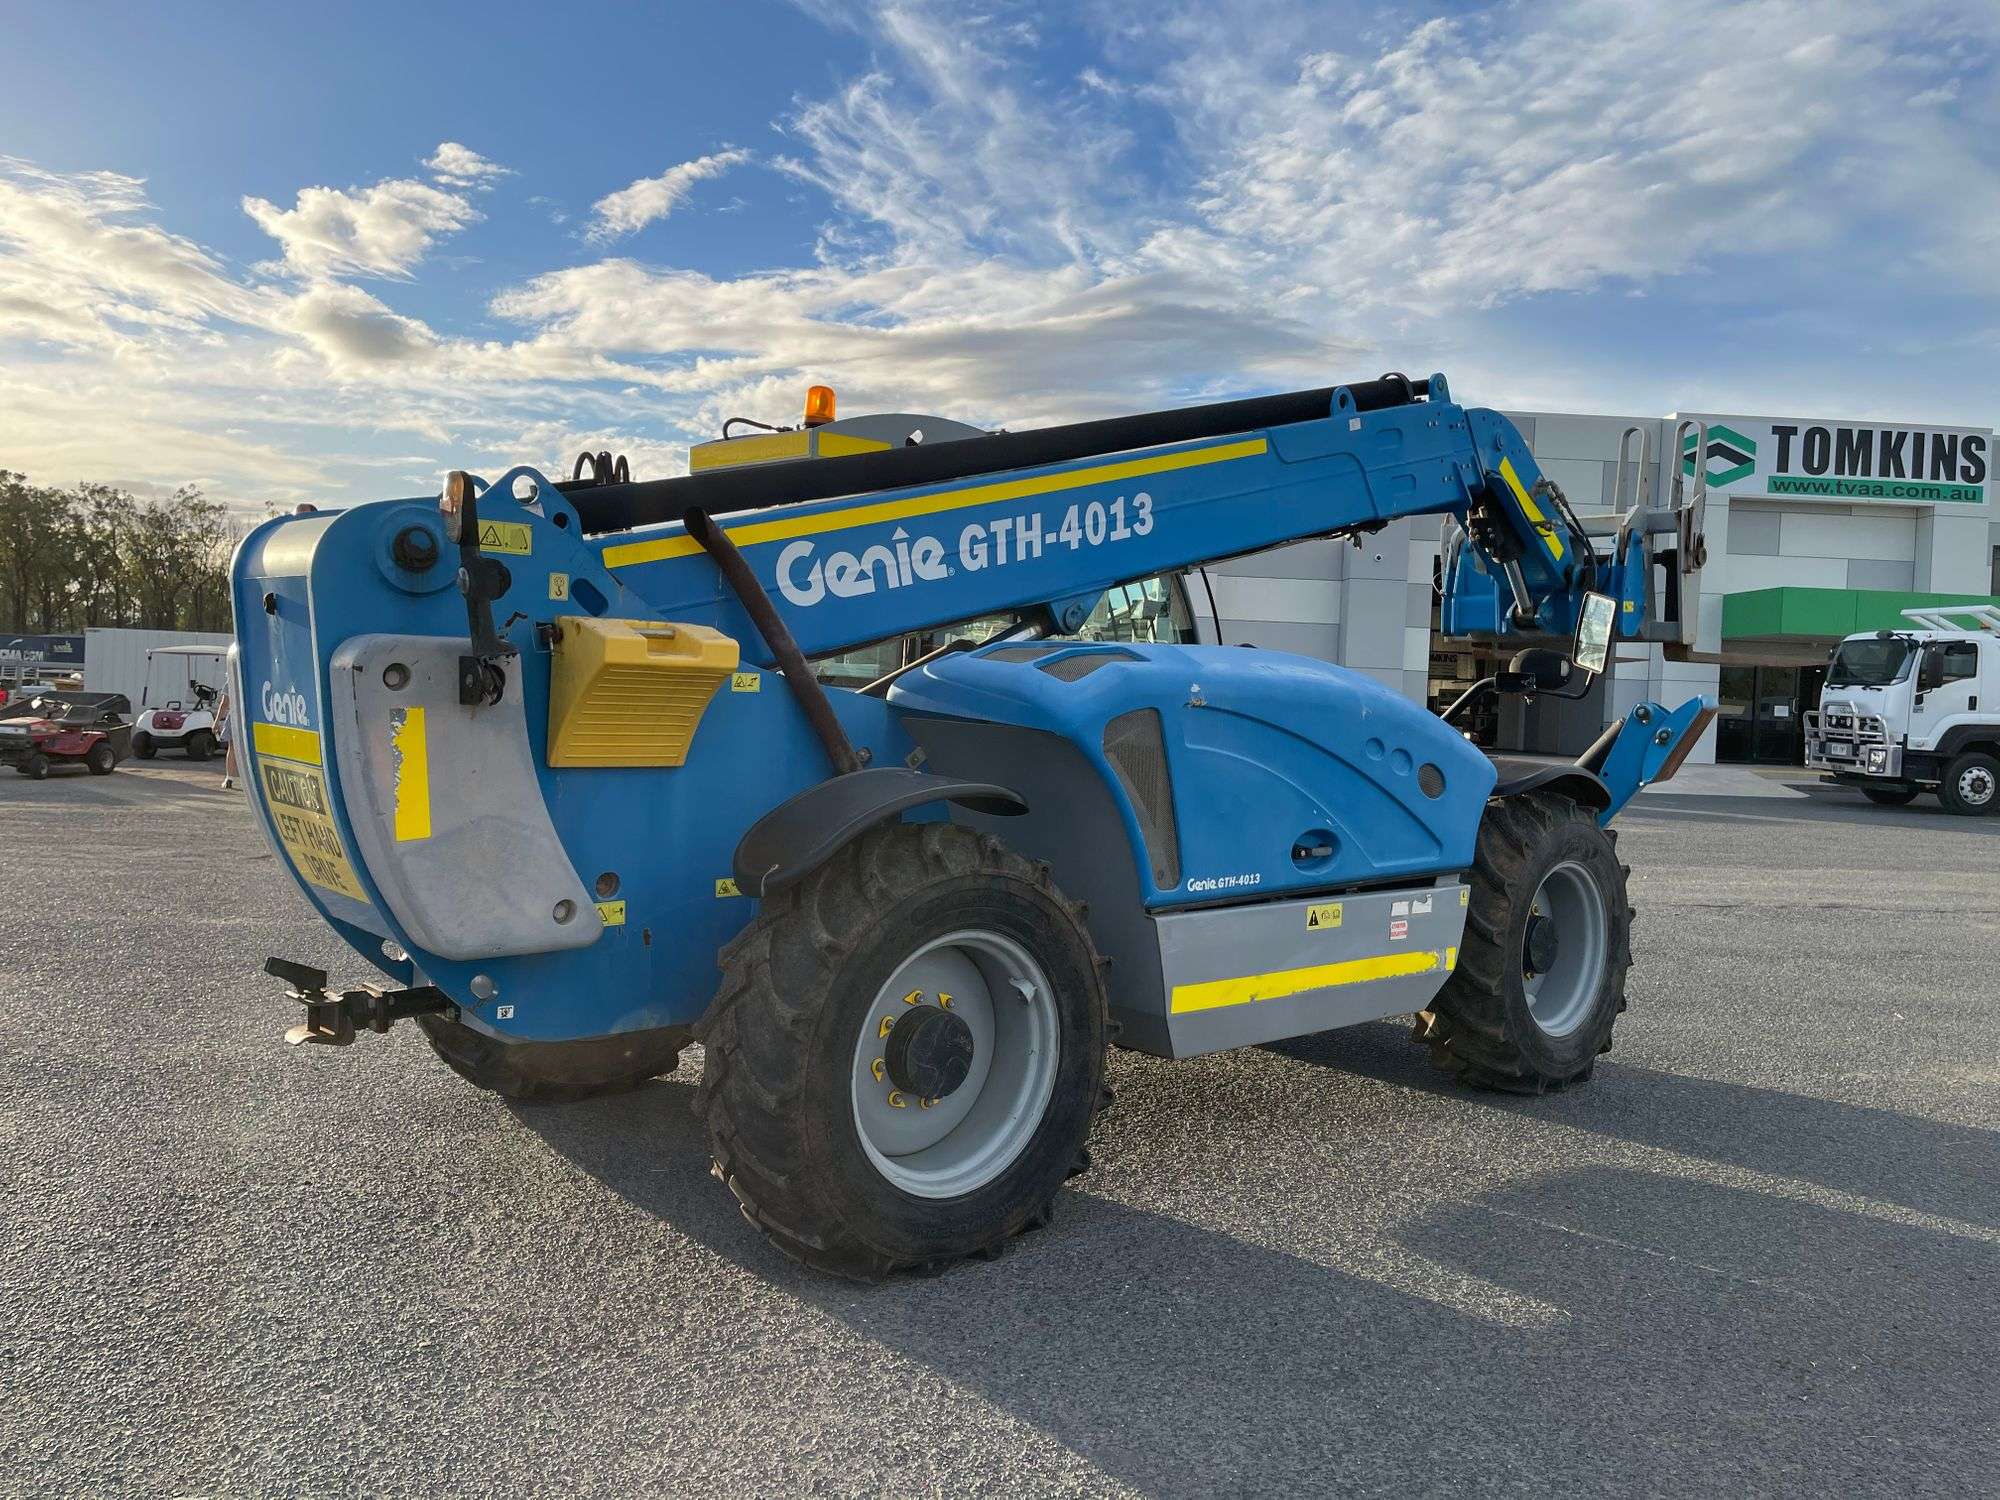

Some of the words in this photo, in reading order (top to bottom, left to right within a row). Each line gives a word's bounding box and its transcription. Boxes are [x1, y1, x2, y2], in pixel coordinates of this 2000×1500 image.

[1771, 425, 1987, 485] TOMKINS
[1773, 479, 1977, 501] www.tvaa.com.au
[775, 526, 948, 607] Genie
[959, 492, 1153, 572] GTH-4013
[262, 680, 309, 726] Genie
[273, 811, 307, 846] LEFT
[302, 819, 342, 859] HAND
[302, 852, 349, 892] DRIVE
[1187, 877, 1217, 892] Genie
[1217, 872, 1261, 889] GTH-4013
